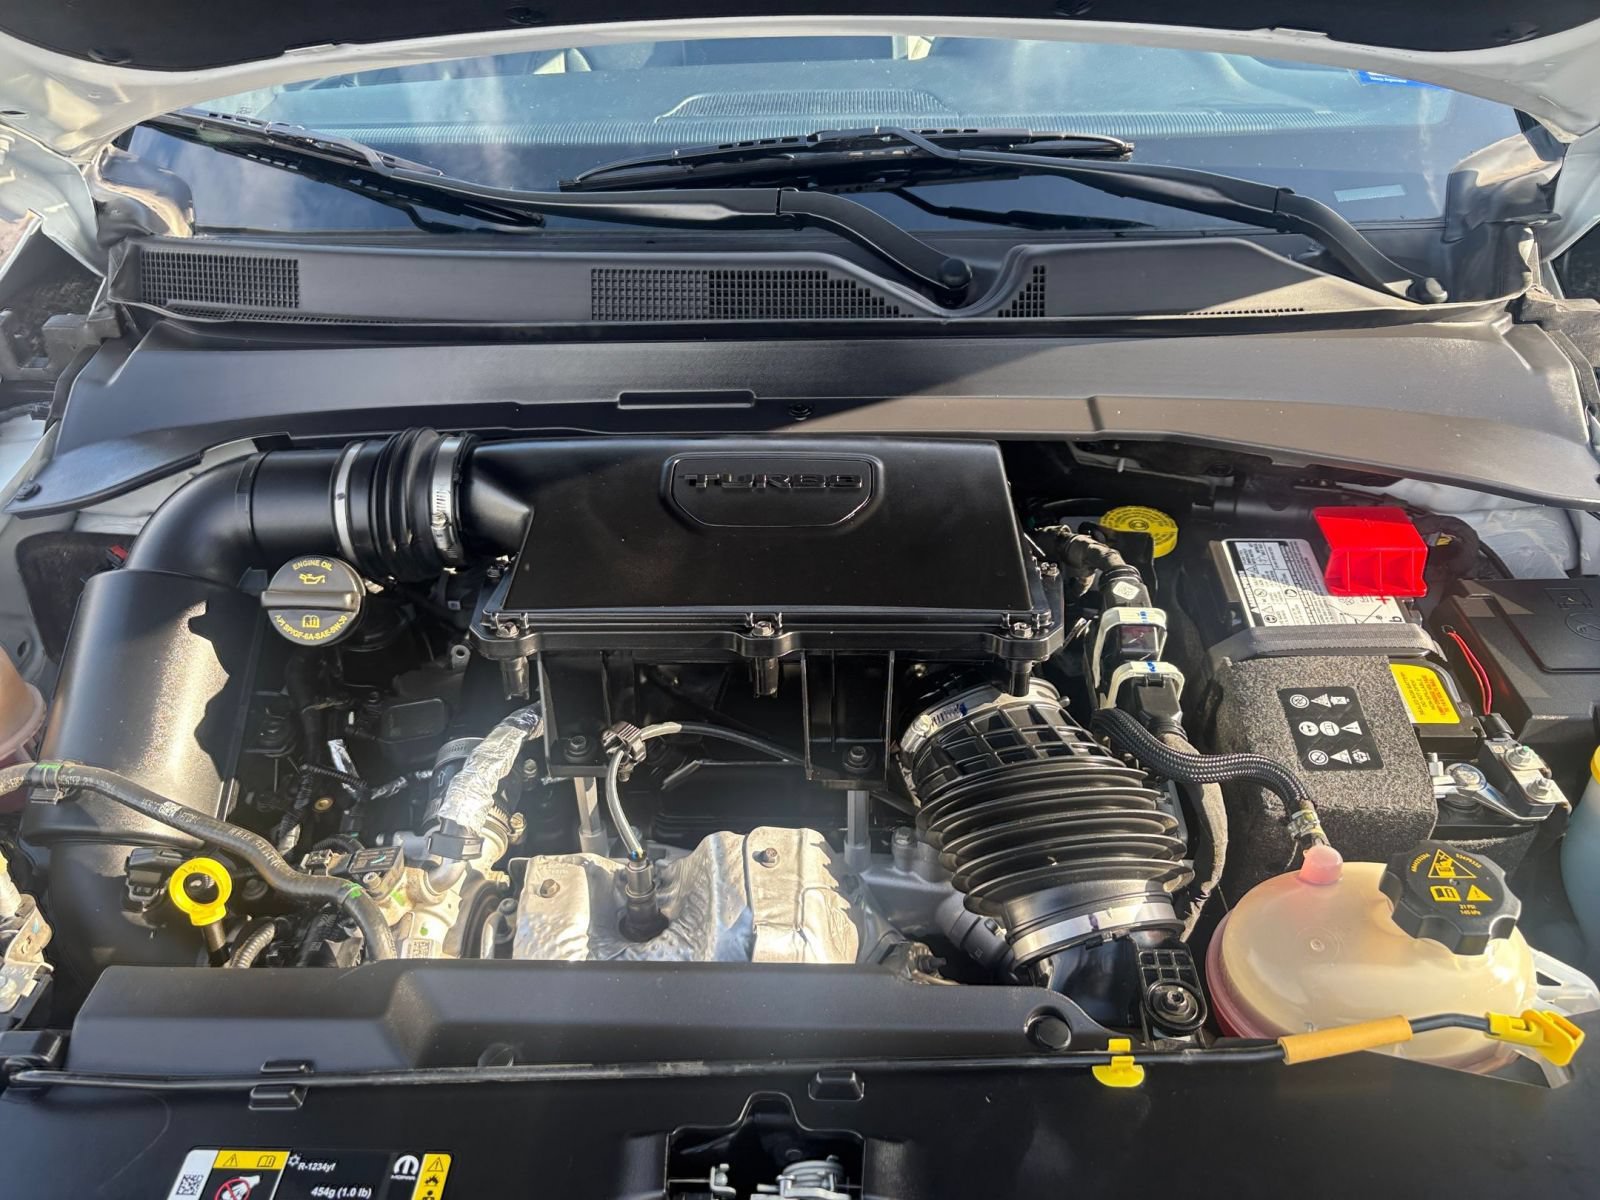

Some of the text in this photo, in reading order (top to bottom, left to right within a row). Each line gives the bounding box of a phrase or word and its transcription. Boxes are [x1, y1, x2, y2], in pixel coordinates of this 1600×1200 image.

[678, 472, 863, 490] TURBO
[292, 560, 334, 571] ENGINE OIL
[298, 1162, 336, 1172] R-1234yf
[311, 1186, 372, 1198] 454g (1.0 lb)
